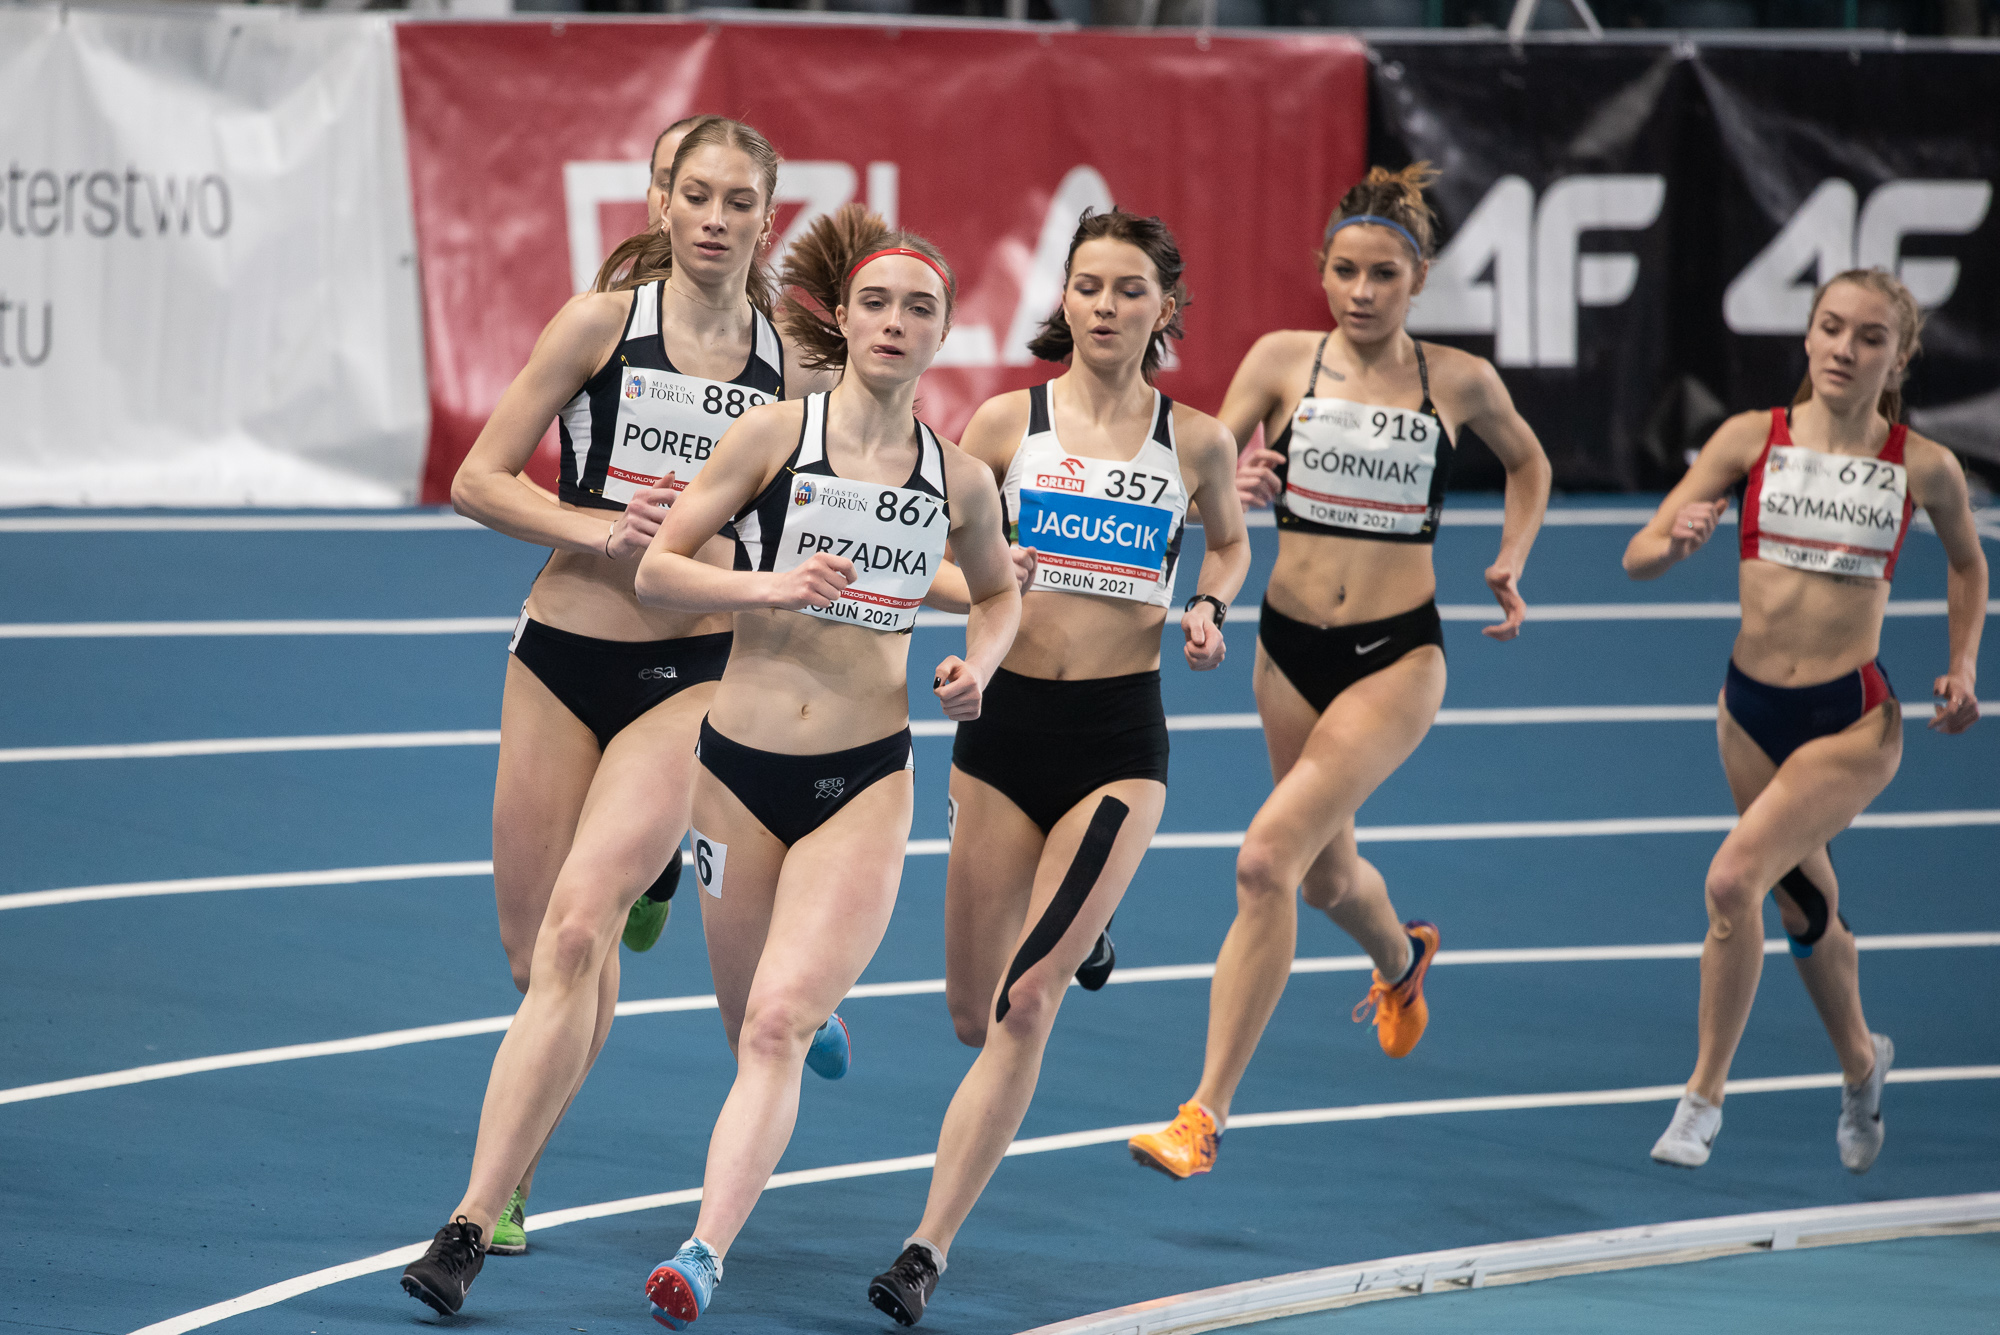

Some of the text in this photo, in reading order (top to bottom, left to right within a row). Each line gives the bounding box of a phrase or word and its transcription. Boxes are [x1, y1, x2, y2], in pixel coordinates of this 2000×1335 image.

[0, 160, 232, 238] terstwo
[1723, 178, 1993, 335] 4F
[1404, 174, 1667, 368] 4F
[649, 387, 695, 405] TORUŃ
[652, 380, 686, 392] MIASTO
[1372, 411, 1428, 442] 918
[622, 422, 721, 464] PORĘB
[613, 470, 631, 480] PZLA
[1303, 447, 1421, 485] GÓRNIAK
[1839, 461, 1897, 492] 672
[823, 487, 860, 499] MIASTO
[1038, 476, 1083, 491] ORLEN
[1104, 469, 1169, 504] 357
[819, 494, 869, 513] TORUŃ
[875, 491, 939, 528] 867
[1310, 503, 1396, 529] TORUŃ 2021
[1031, 509, 1160, 552] JAGUŚCIK
[797, 532, 927, 576] PRZĄDKA
[1037, 554, 1063, 565] HALOWE
[1064, 559, 1112, 572] MISTRZOSTWA
[1113, 566, 1136, 576] POLSKI
[1832, 556, 1862, 572] 2021
[1043, 569, 1134, 595] TORUŃ 2021
[841, 589, 878, 602] TRZOSTWA
[879, 597, 902, 606] POLSKI
[804, 601, 899, 626] RUŃ 2021
[696, 838, 713, 886] 6
